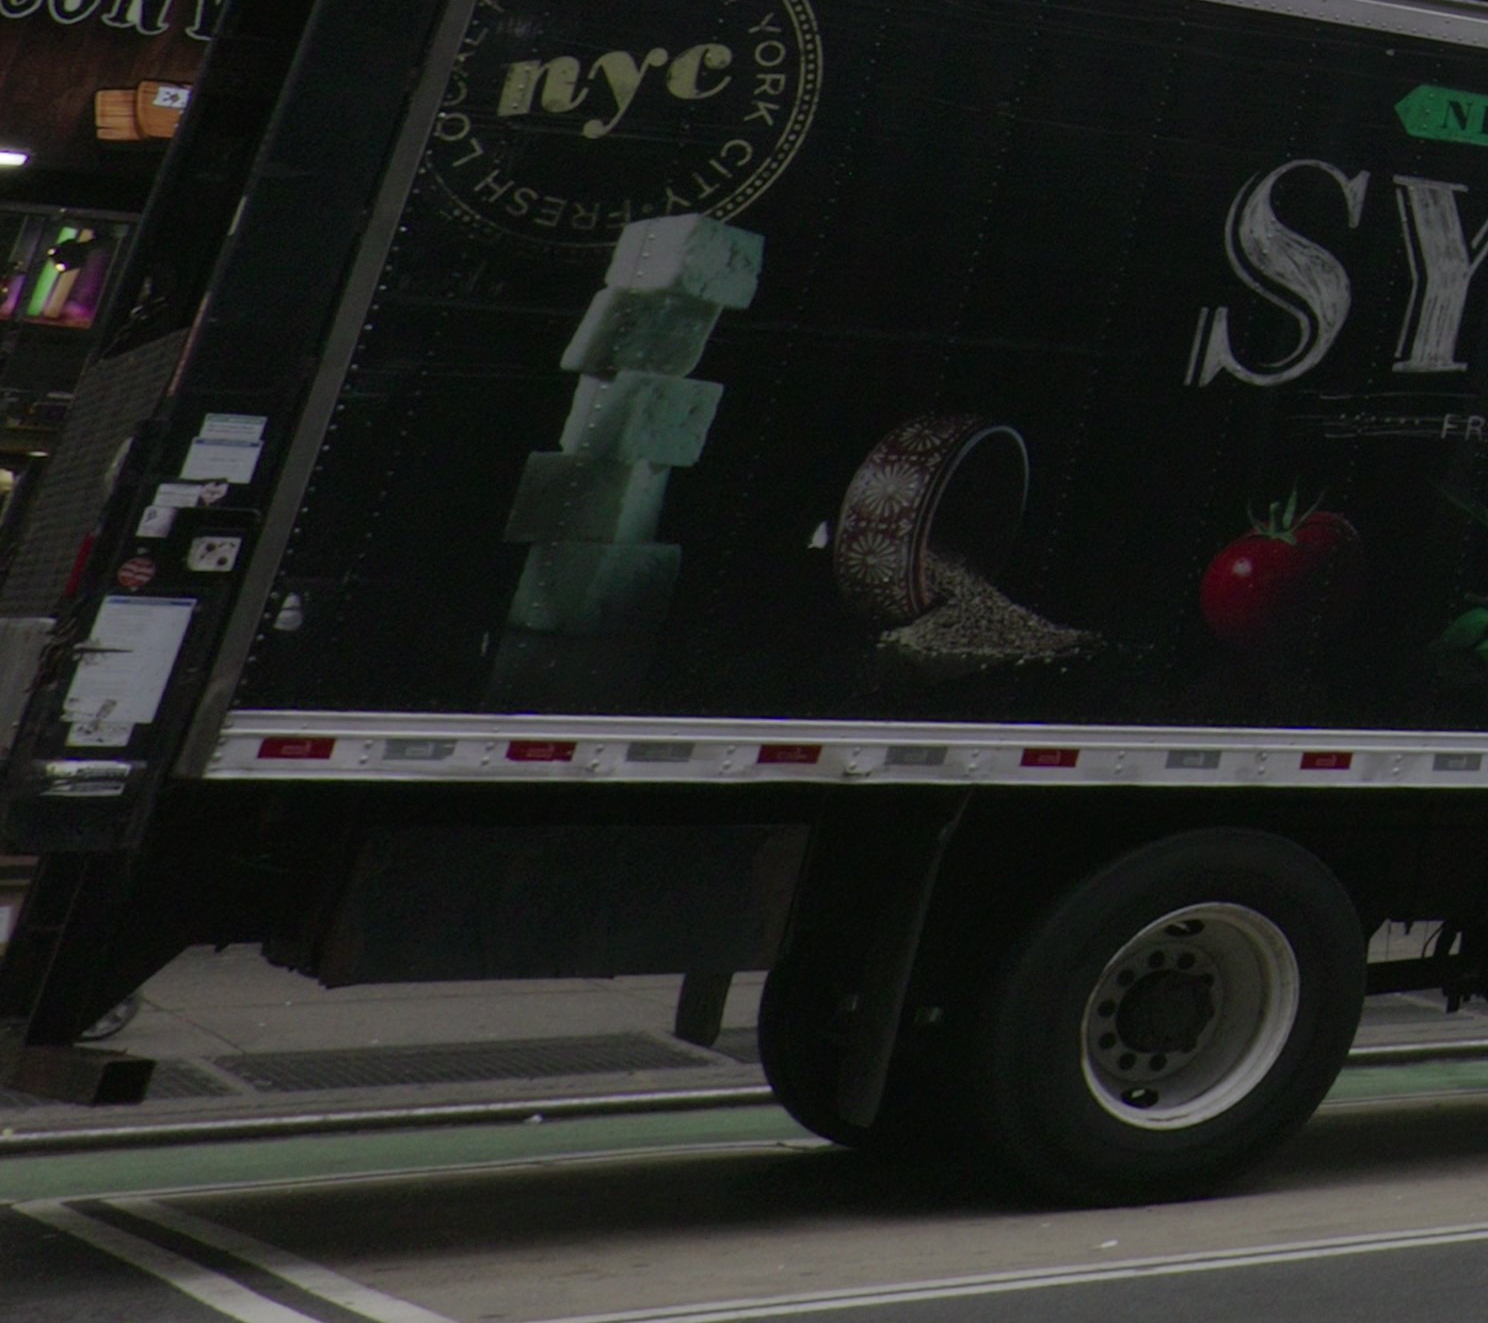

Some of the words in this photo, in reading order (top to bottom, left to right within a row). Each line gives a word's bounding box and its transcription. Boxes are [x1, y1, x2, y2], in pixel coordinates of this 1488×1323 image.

[496, 42, 733, 140] nyc
[743, 12, 787, 127] YORK
[665, 138, 754, 208] CITY
